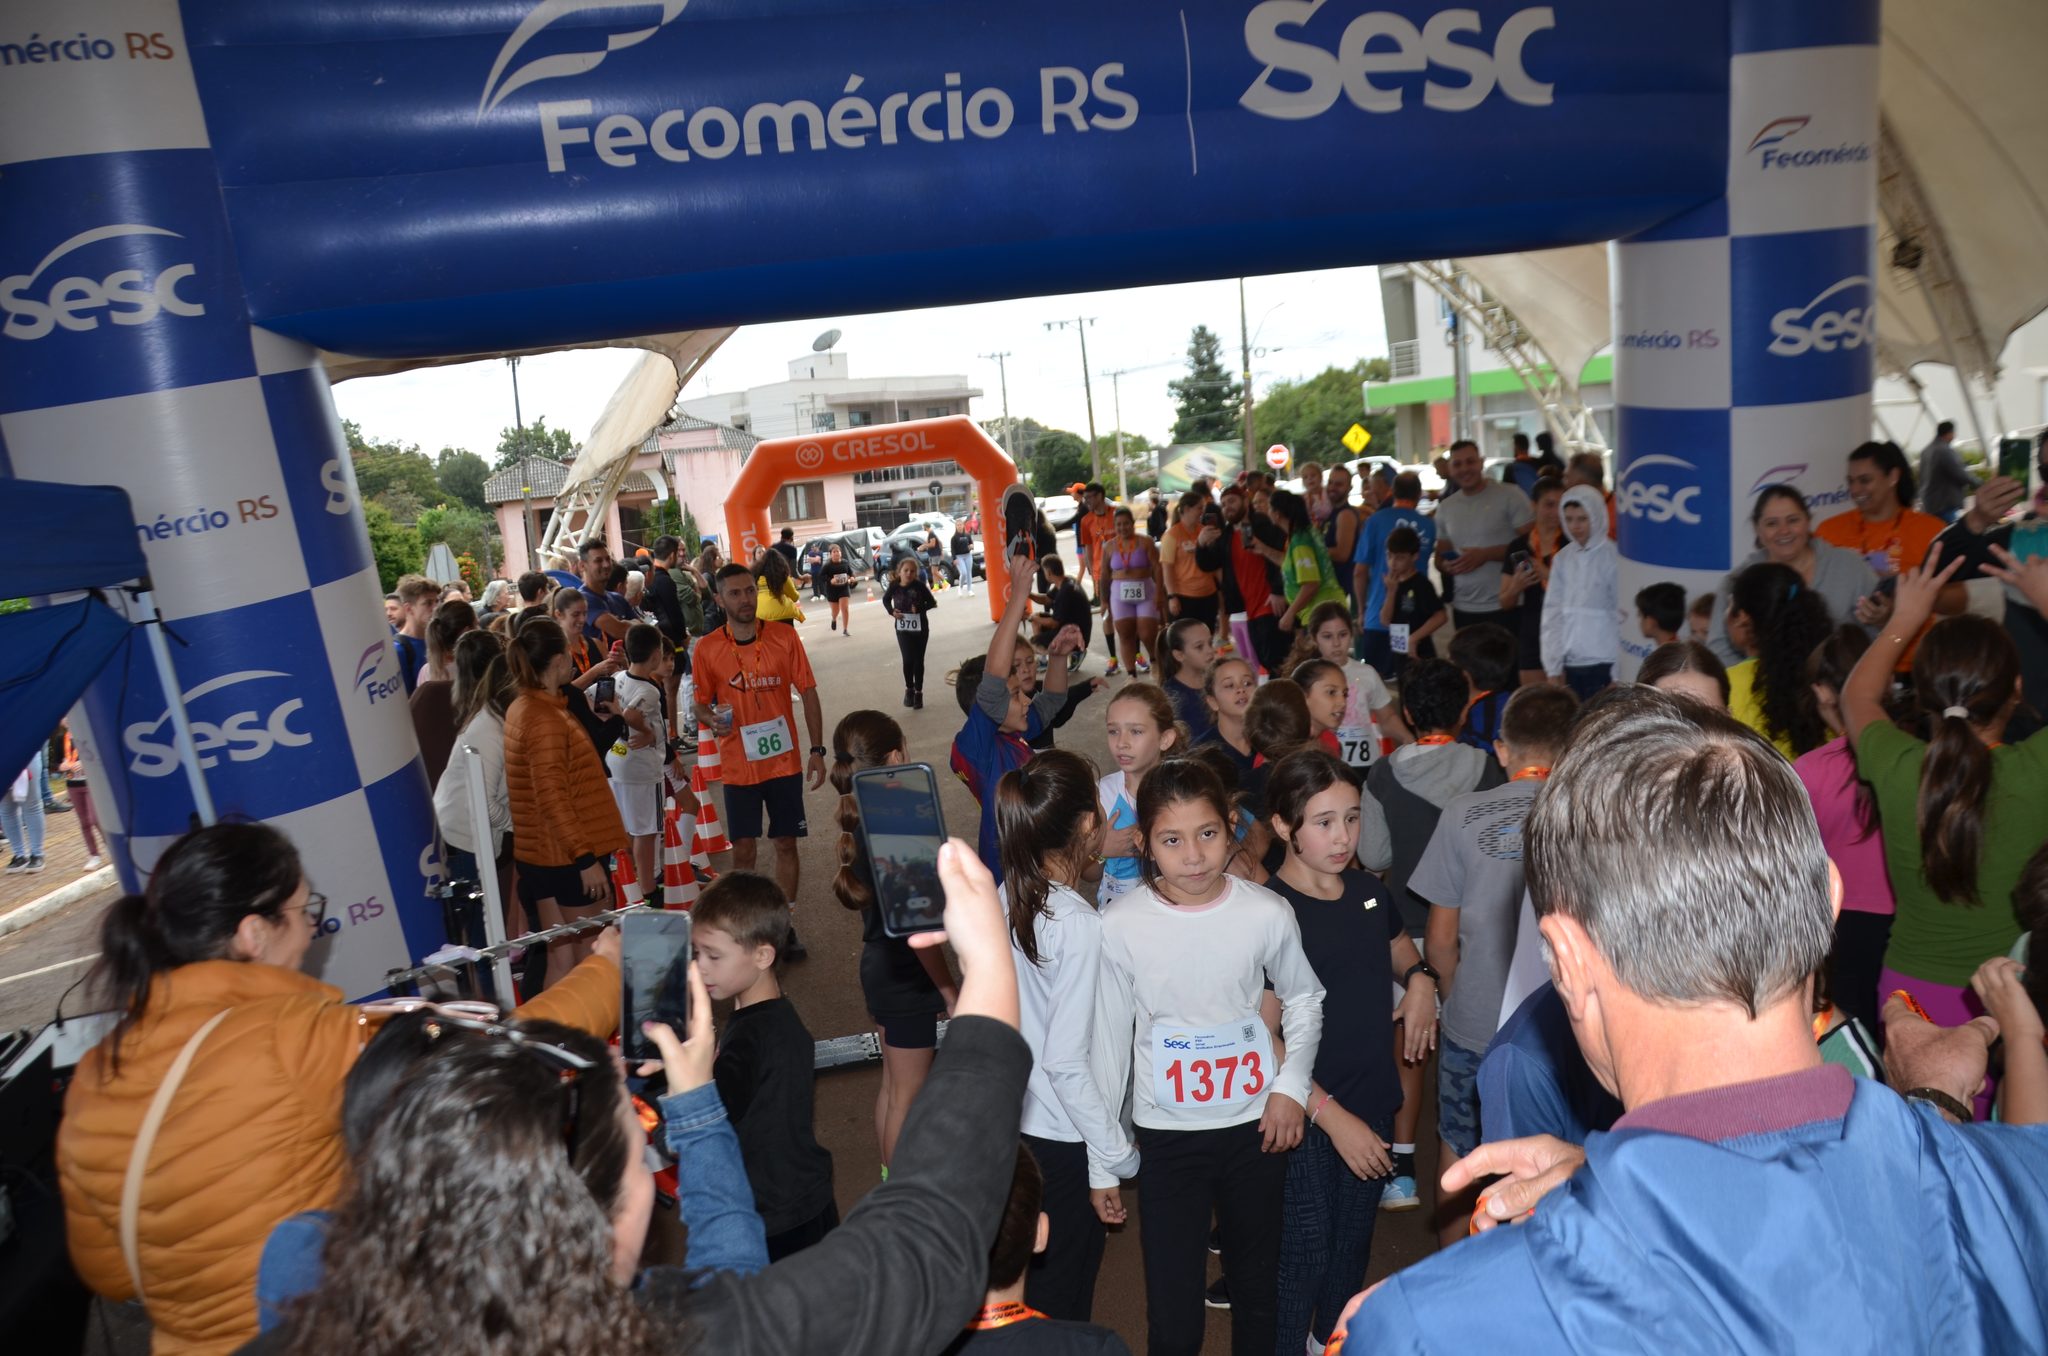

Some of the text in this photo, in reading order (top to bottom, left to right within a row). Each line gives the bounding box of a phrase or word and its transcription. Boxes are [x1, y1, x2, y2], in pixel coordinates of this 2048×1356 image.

[125, 32, 174, 60] RS
[1238, 0, 1556, 120] Sesc
[538, 62, 1140, 173] Fecomércio RS
[1688, 328, 1720, 348] RS
[832, 430, 936, 461] CRESOL
[237, 494, 279, 523] RS
[1123, 588, 1142, 599] 738
[899, 619, 918, 630] 970
[757, 732, 782, 756] 86
[348, 895, 385, 926] RS
[1163, 1038, 1191, 1050] Sesc
[1166, 1050, 1265, 1103] 1373
